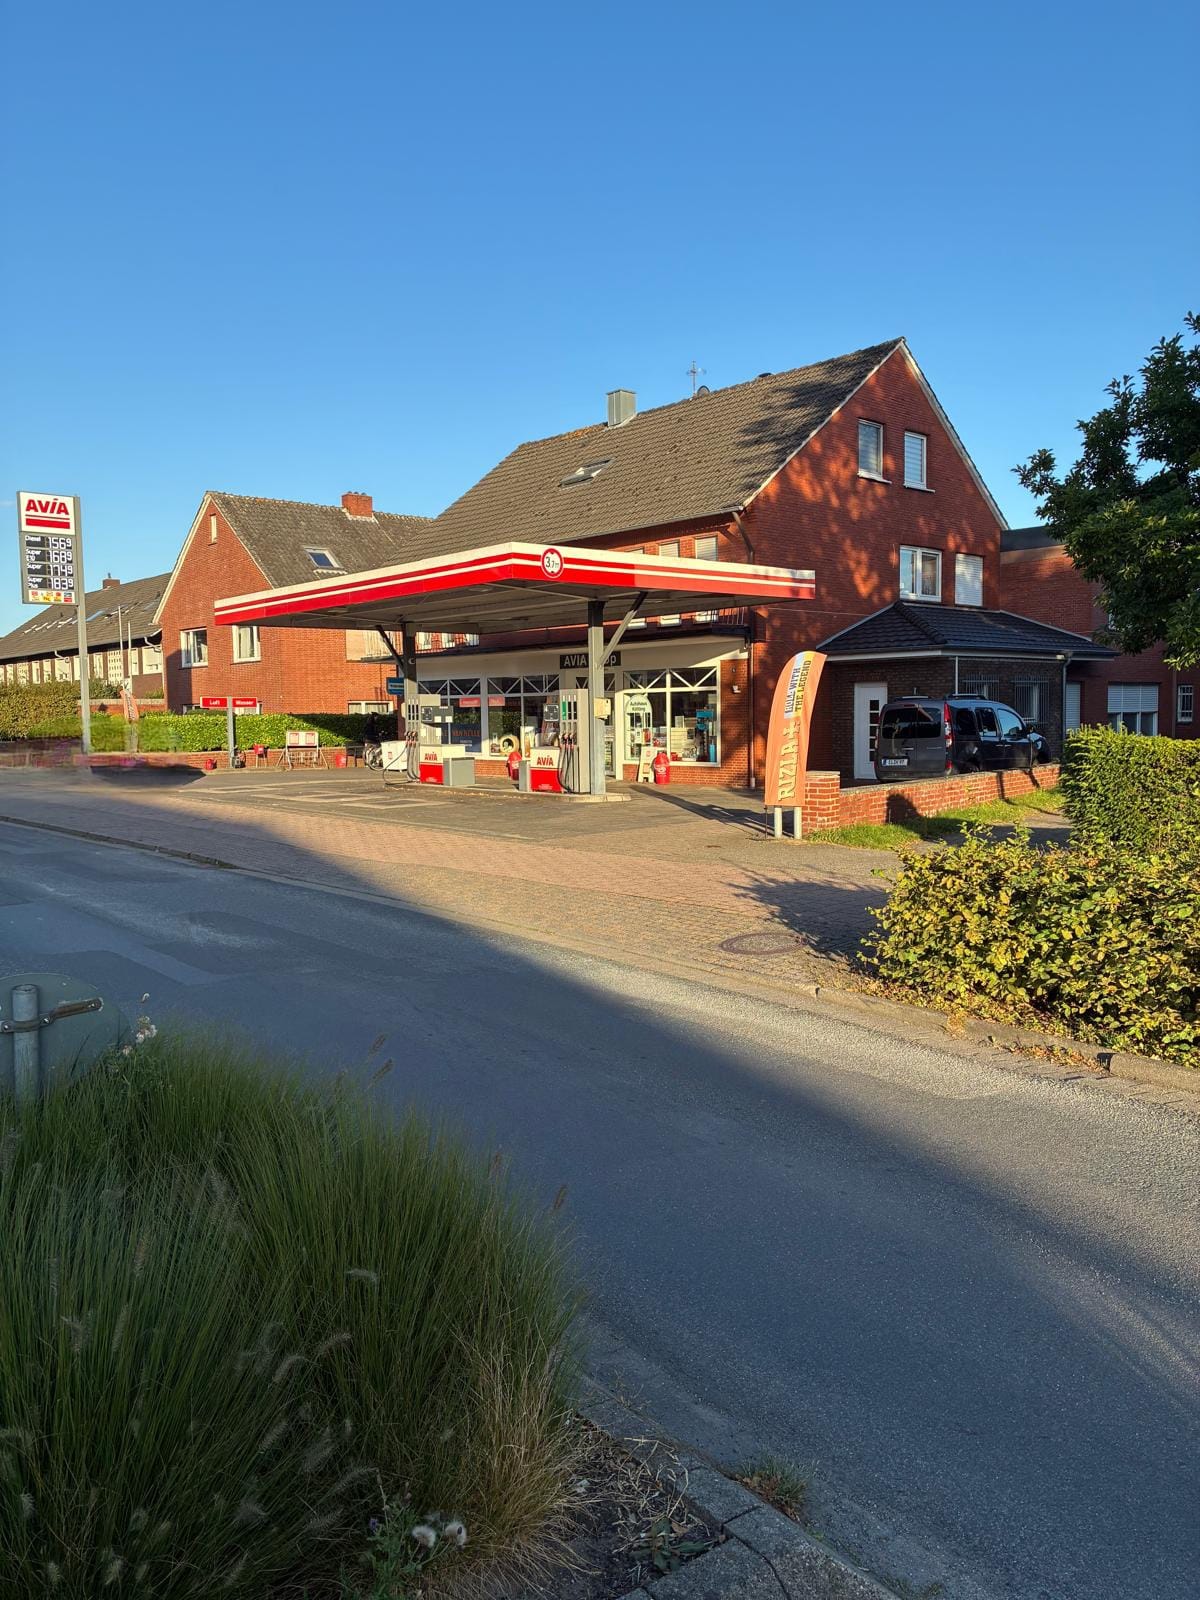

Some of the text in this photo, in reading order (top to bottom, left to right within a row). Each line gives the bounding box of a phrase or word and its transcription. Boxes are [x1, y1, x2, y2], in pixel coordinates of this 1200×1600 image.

[563, 655, 587, 667] AVIA
[788, 667, 801, 692] WITH
[794, 660, 812, 712] THE LEGEND
